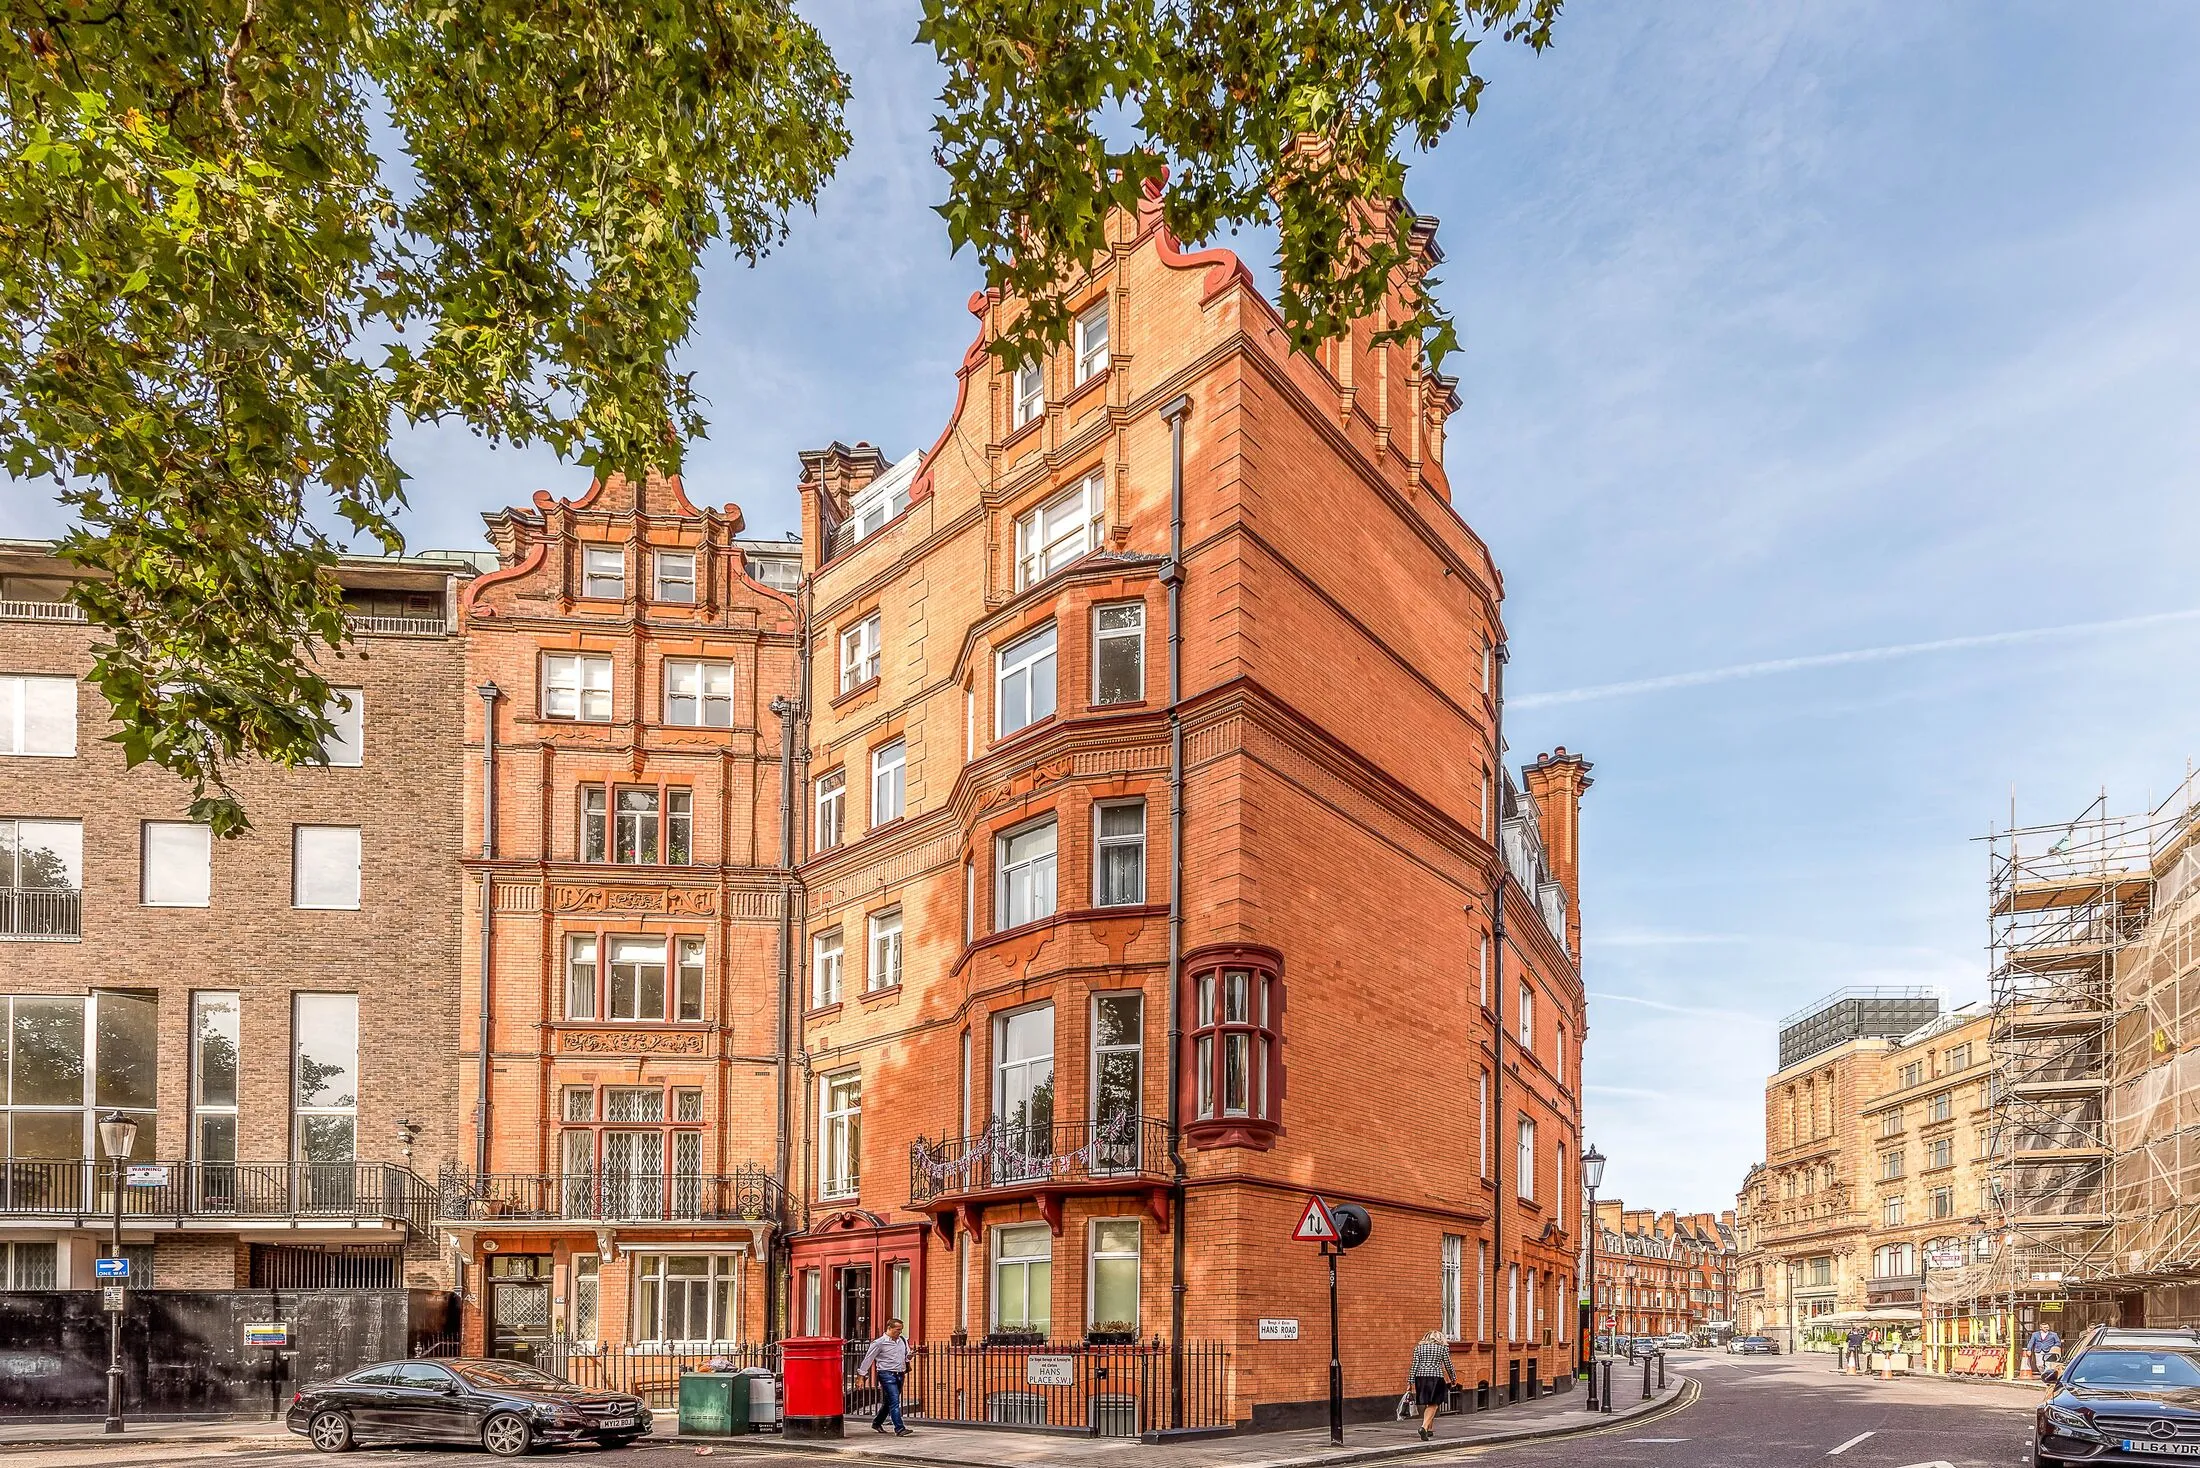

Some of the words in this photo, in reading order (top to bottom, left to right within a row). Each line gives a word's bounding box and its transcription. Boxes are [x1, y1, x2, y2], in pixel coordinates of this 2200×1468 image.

[1261, 1326, 1278, 1334] HANS
[1281, 1326, 1296, 1334] ROAD
[2132, 1441, 2168, 1452] LL64
[2172, 1444, 2199, 1454] YDR
